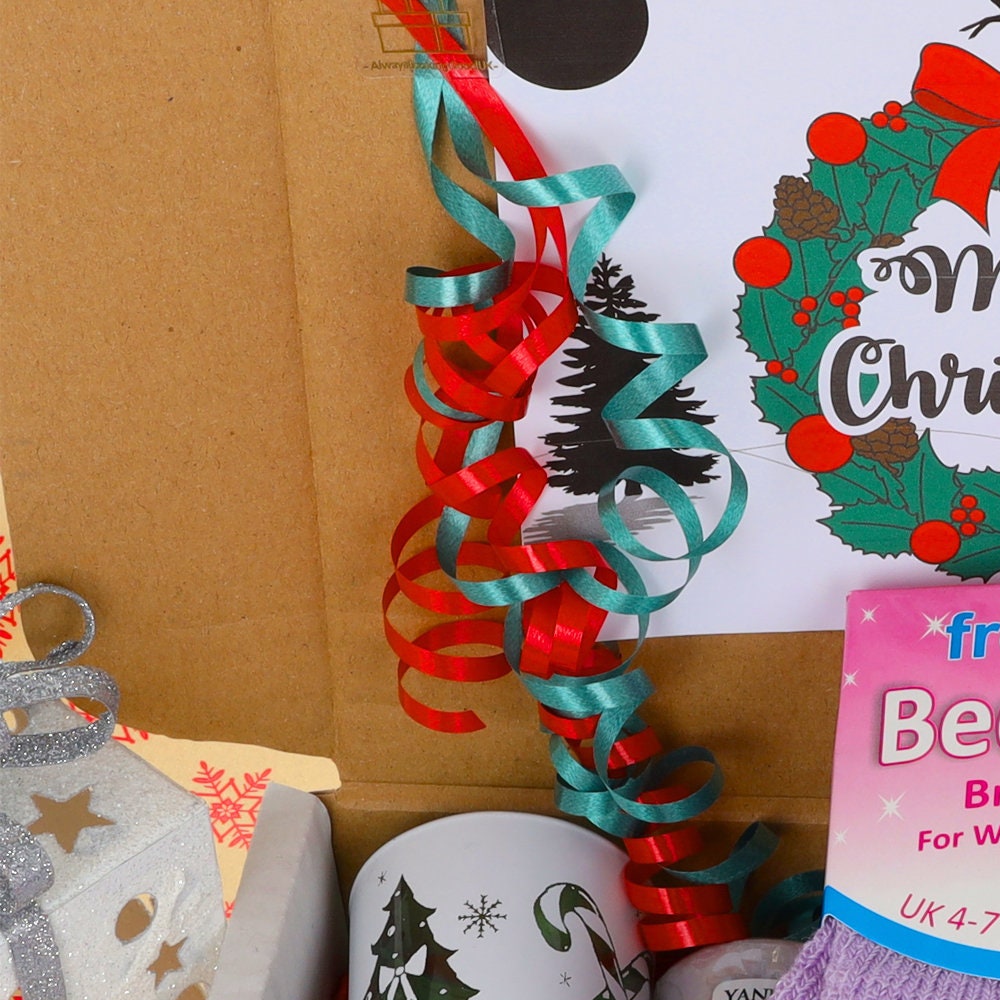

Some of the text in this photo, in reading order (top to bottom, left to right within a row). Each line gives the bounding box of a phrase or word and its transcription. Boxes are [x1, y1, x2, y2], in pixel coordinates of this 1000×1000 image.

[917, 828, 965, 852] For
[899, 893, 1000, 935] UK 4-7
